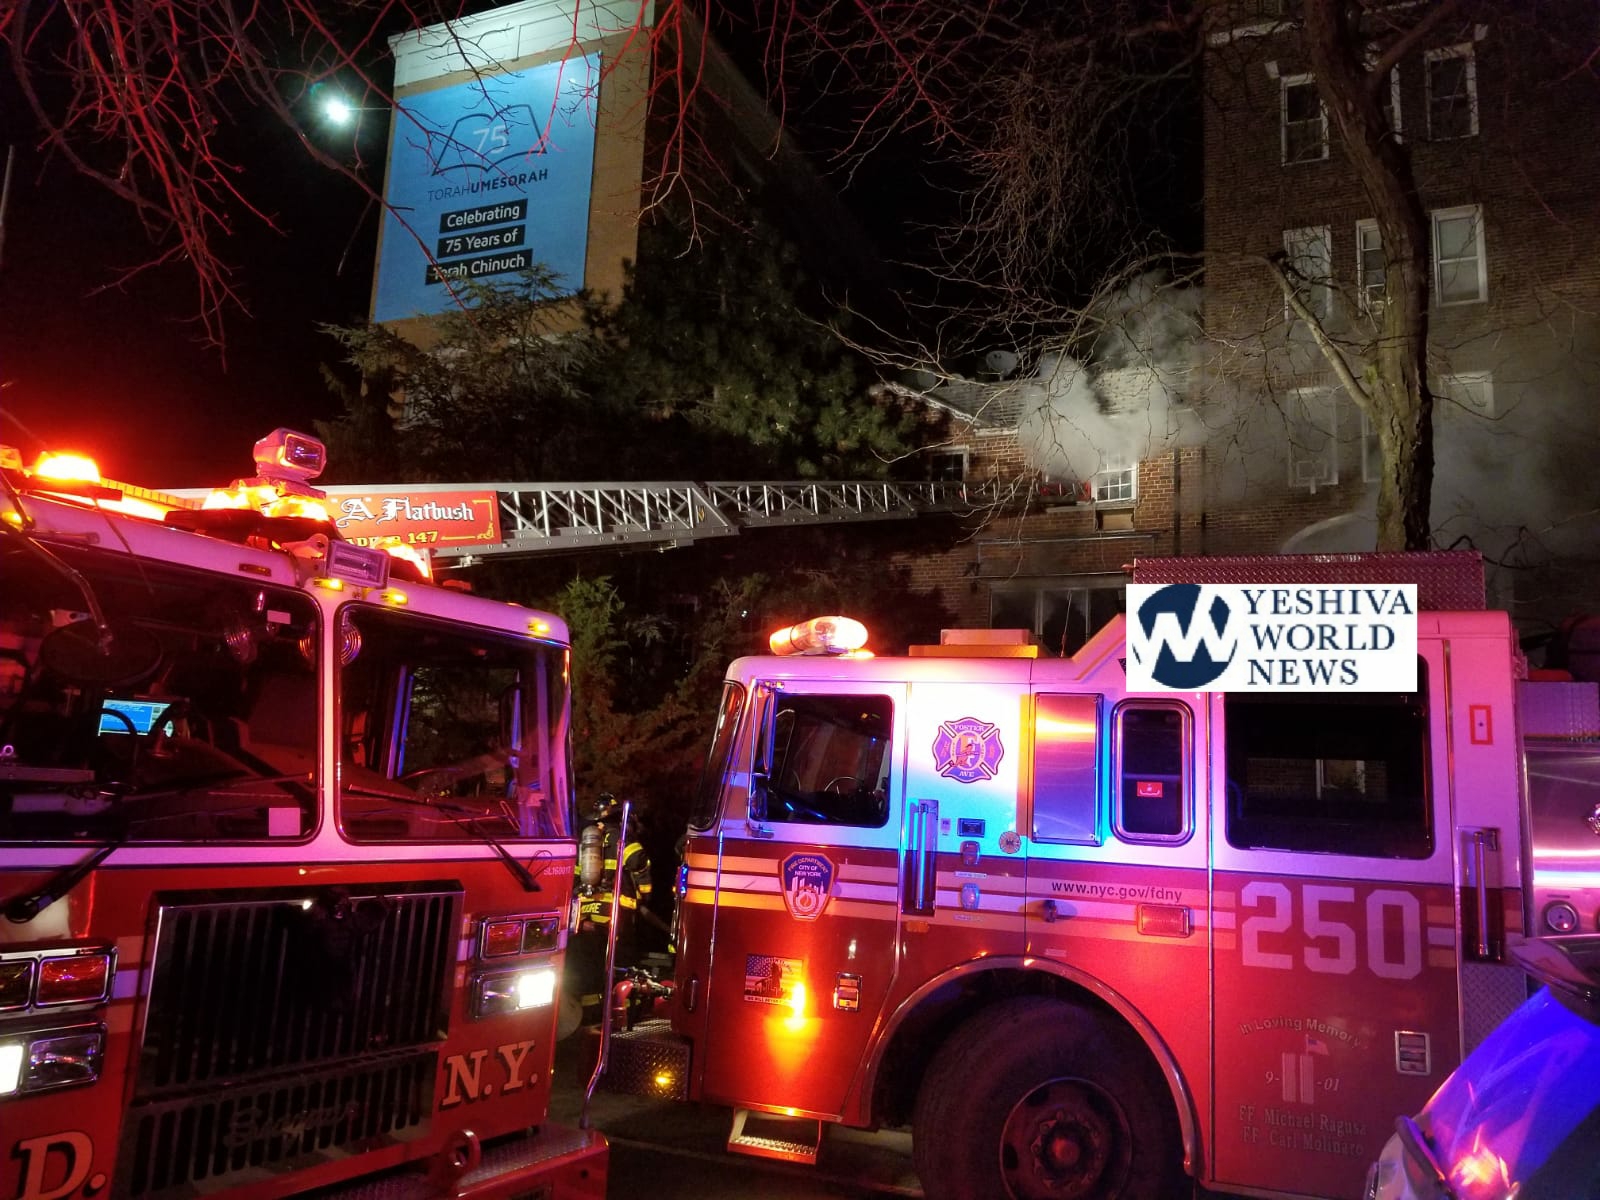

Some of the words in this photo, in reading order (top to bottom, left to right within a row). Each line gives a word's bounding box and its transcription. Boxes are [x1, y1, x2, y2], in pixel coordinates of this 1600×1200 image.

[473, 124, 507, 157] 75
[447, 205, 520, 227] Celebrating
[446, 239, 461, 254] 75
[466, 233, 501, 250] Years
[503, 228, 519, 244] of
[433, 263, 468, 280] Torah
[471, 254, 525, 274] Chinuch
[377, 497, 475, 525] Flatbush
[408, 531, 438, 544] 147
[954, 724, 985, 732] FOSTER
[1051, 881, 1183, 903] www.nyc.gov/fdny
[1241, 881, 1422, 980] 250
[1240, 1022, 1252, 1035] In
[1254, 1016, 1302, 1031] Loving
[1264, 1108, 1315, 1129] Michael
[1319, 1113, 1367, 1138] Ragusa
[1270, 1130, 1297, 1149] Carl
